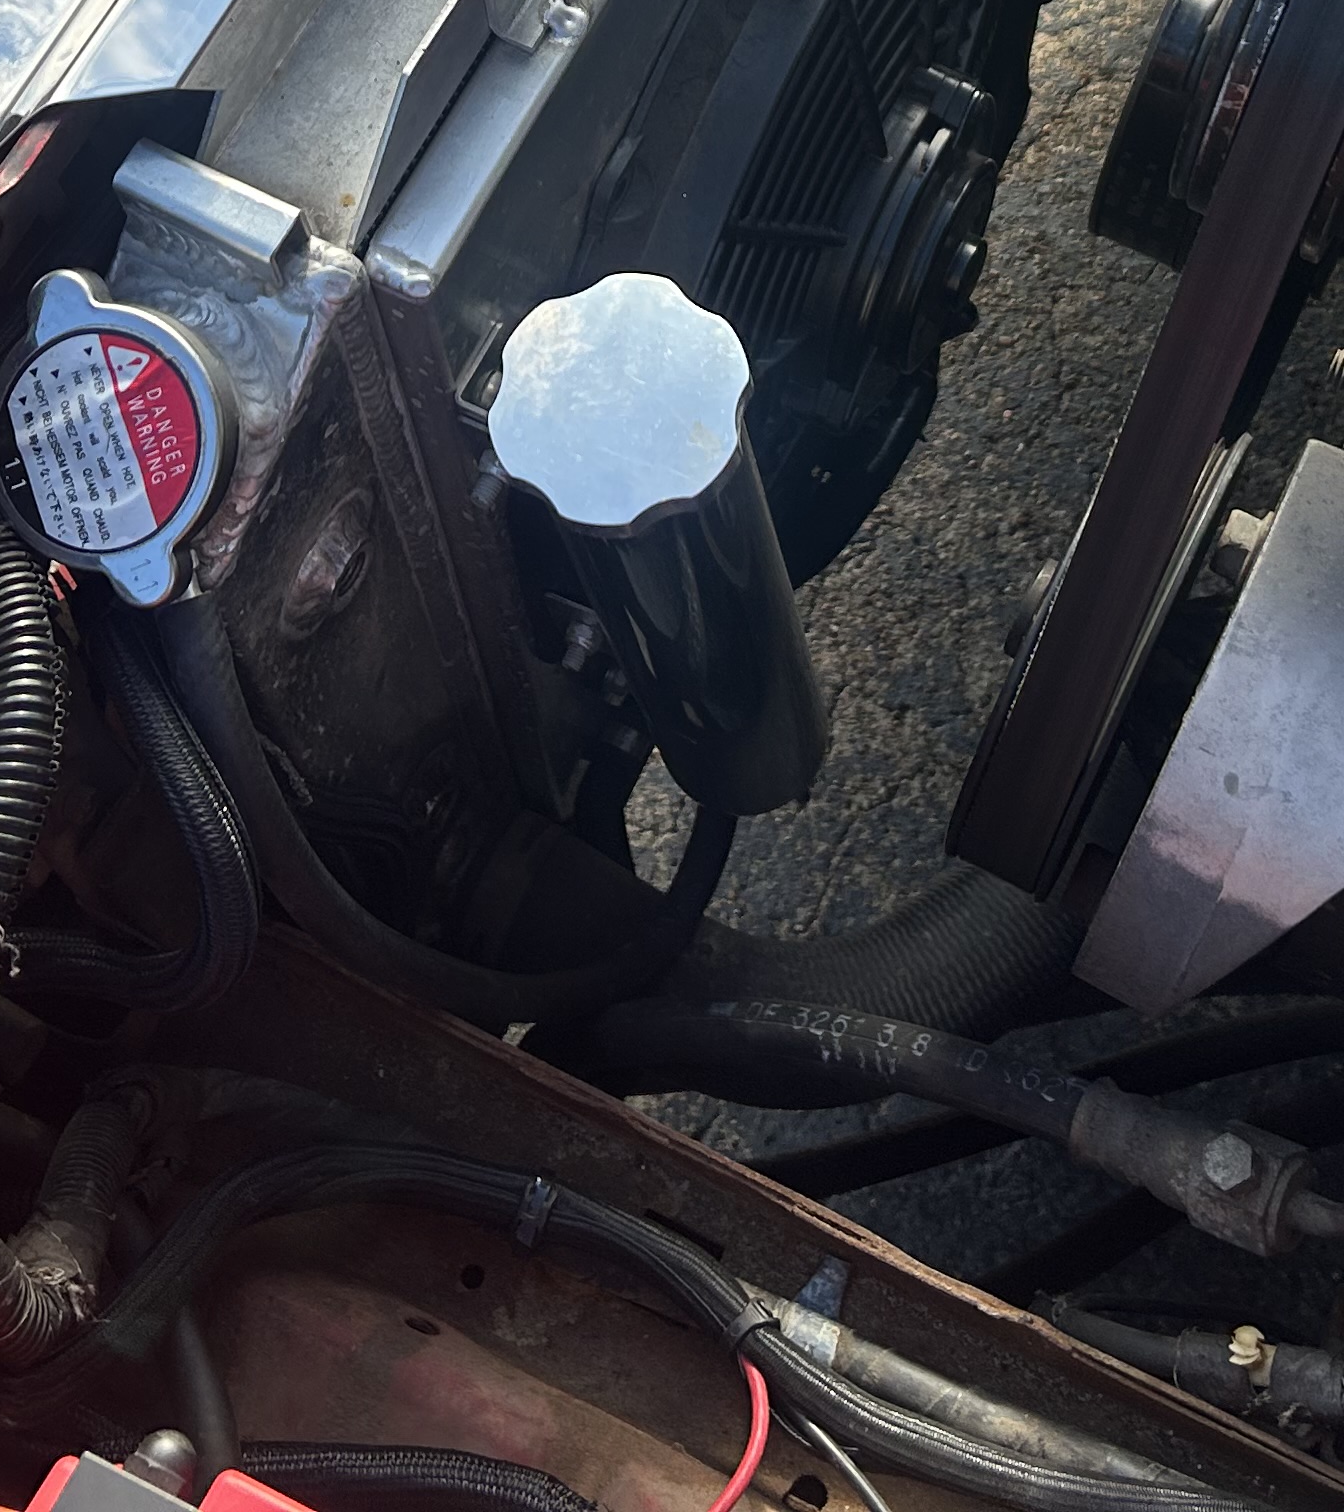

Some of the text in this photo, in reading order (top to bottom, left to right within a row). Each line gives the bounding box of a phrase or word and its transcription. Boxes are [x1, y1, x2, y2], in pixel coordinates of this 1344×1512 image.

[32, 379, 48, 408] NICHT
[70, 369, 83, 386] Hot
[40, 410, 53, 426] BEI
[75, 393, 93, 424] coolant
[88, 362, 106, 395] NEVER
[98, 401, 115, 429] OPEN
[108, 431, 126, 461] WHEN
[44, 427, 66, 469] HEISSEM
[88, 431, 99, 445] will
[127, 395, 167, 487] WARNING
[145, 387, 187, 478] DANGER
[57, 400, 78, 438] OUVREZ
[72, 440, 86, 460] PAS
[80, 466, 100, 502] QUAND
[96, 455, 111, 479] scald
[4, 457, 27, 490] 1.1
[58, 468, 78, 504] MOTOR
